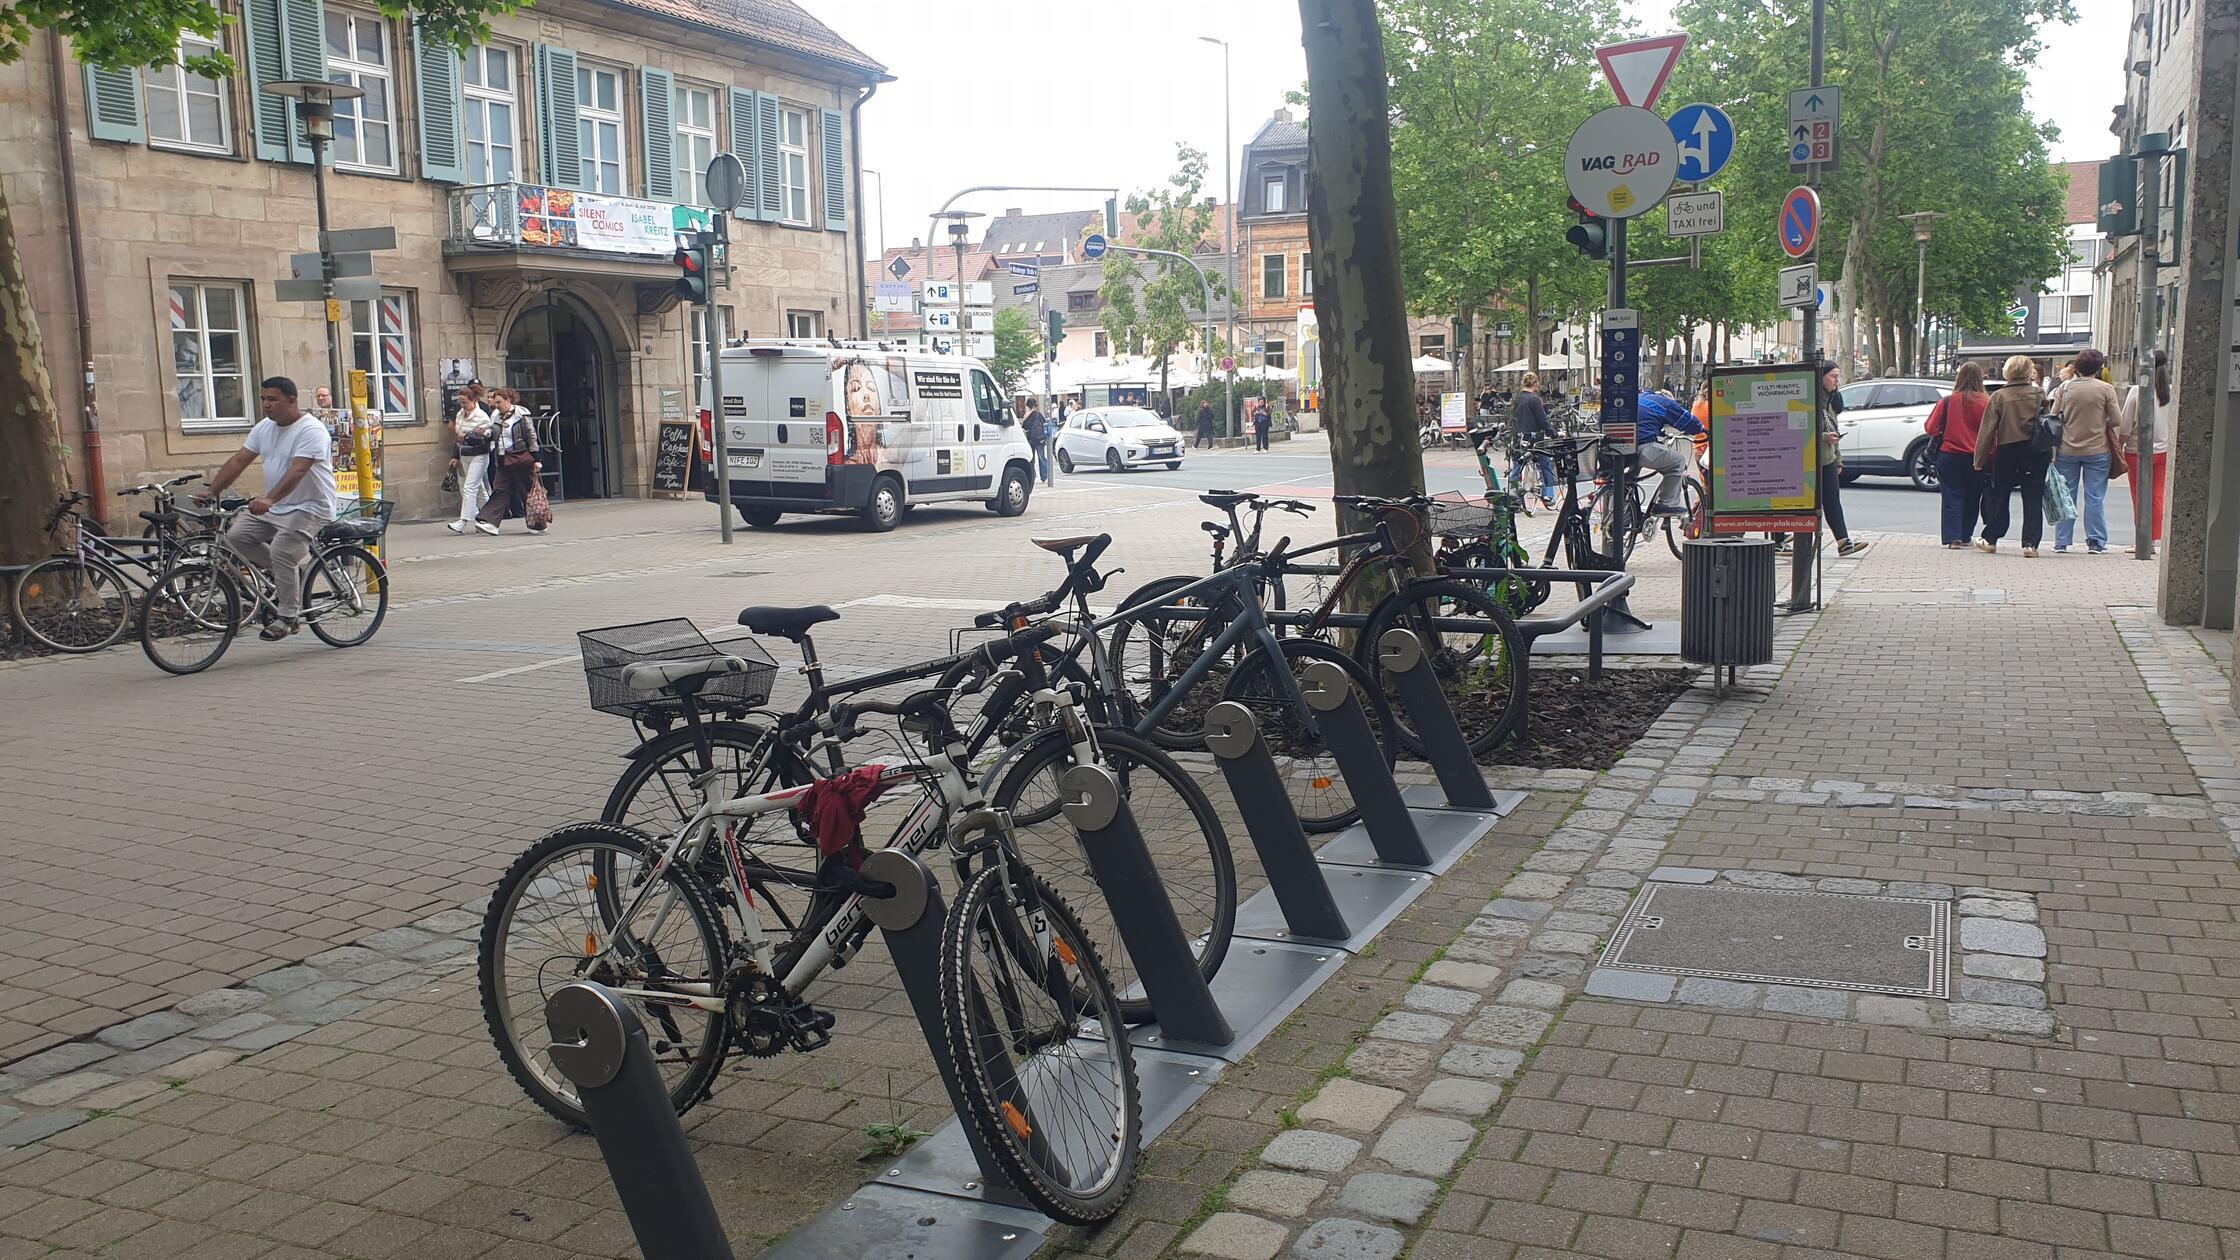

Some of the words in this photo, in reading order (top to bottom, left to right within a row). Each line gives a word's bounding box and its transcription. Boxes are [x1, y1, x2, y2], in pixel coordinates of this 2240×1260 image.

[1817, 124, 1825, 138] 2
[1816, 143, 1825, 158] 3
[1581, 155, 1616, 172] VAG
[1622, 152, 1661, 168] RAD
[1696, 200, 1715, 211] und
[579, 208, 606, 220] SILENT
[631, 213, 656, 225] ISABEL
[592, 220, 624, 232] COMICS
[1672, 218, 1695, 229] TAXI
[1699, 215, 1717, 227] frei
[644, 225, 669, 237] KREITZ
[745, 457, 758, 465] 102
[905, 663, 931, 674] CROSS
